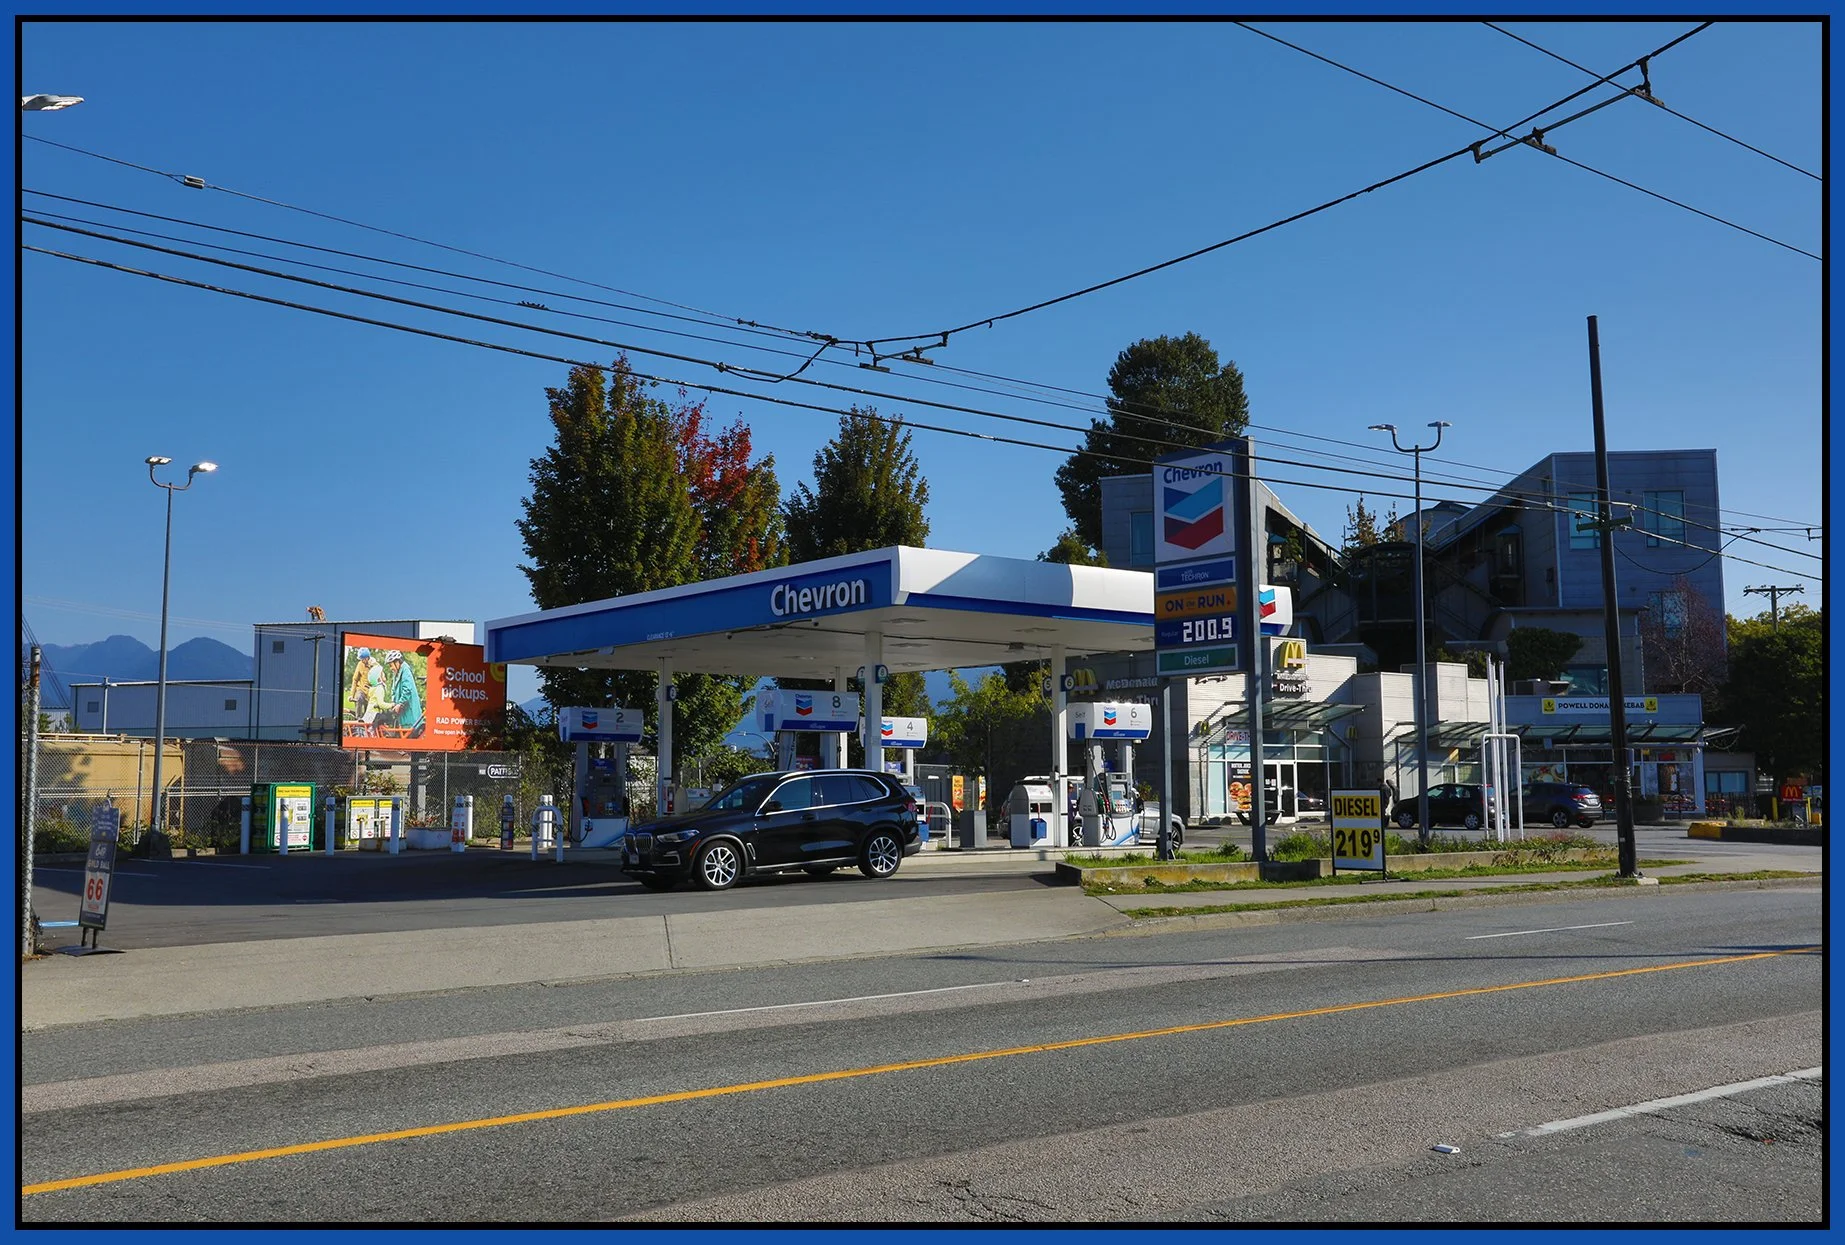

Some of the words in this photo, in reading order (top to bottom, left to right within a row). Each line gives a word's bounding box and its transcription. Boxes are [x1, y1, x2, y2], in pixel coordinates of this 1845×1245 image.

[1163, 461, 1223, 484] Chevron
[1181, 572, 1209, 582] TECHRON
[771, 579, 865, 616] Chevron
[1165, 600, 1184, 612] ON
[1198, 593, 1225, 608] RUN
[1183, 617, 1232, 643] 200.9
[1184, 654, 1209, 666] Diesel
[446, 667, 486, 684] School
[441, 685, 489, 701] pickups.
[832, 696, 842, 708] 8
[616, 712, 624, 723] 2
[1130, 707, 1138, 719] 6
[436, 717, 449, 725] RAD
[450, 718, 474, 726] POWER
[907, 722, 914, 731] 4
[1334, 798, 1377, 816] DIESEL
[87, 878, 104, 901] 66
